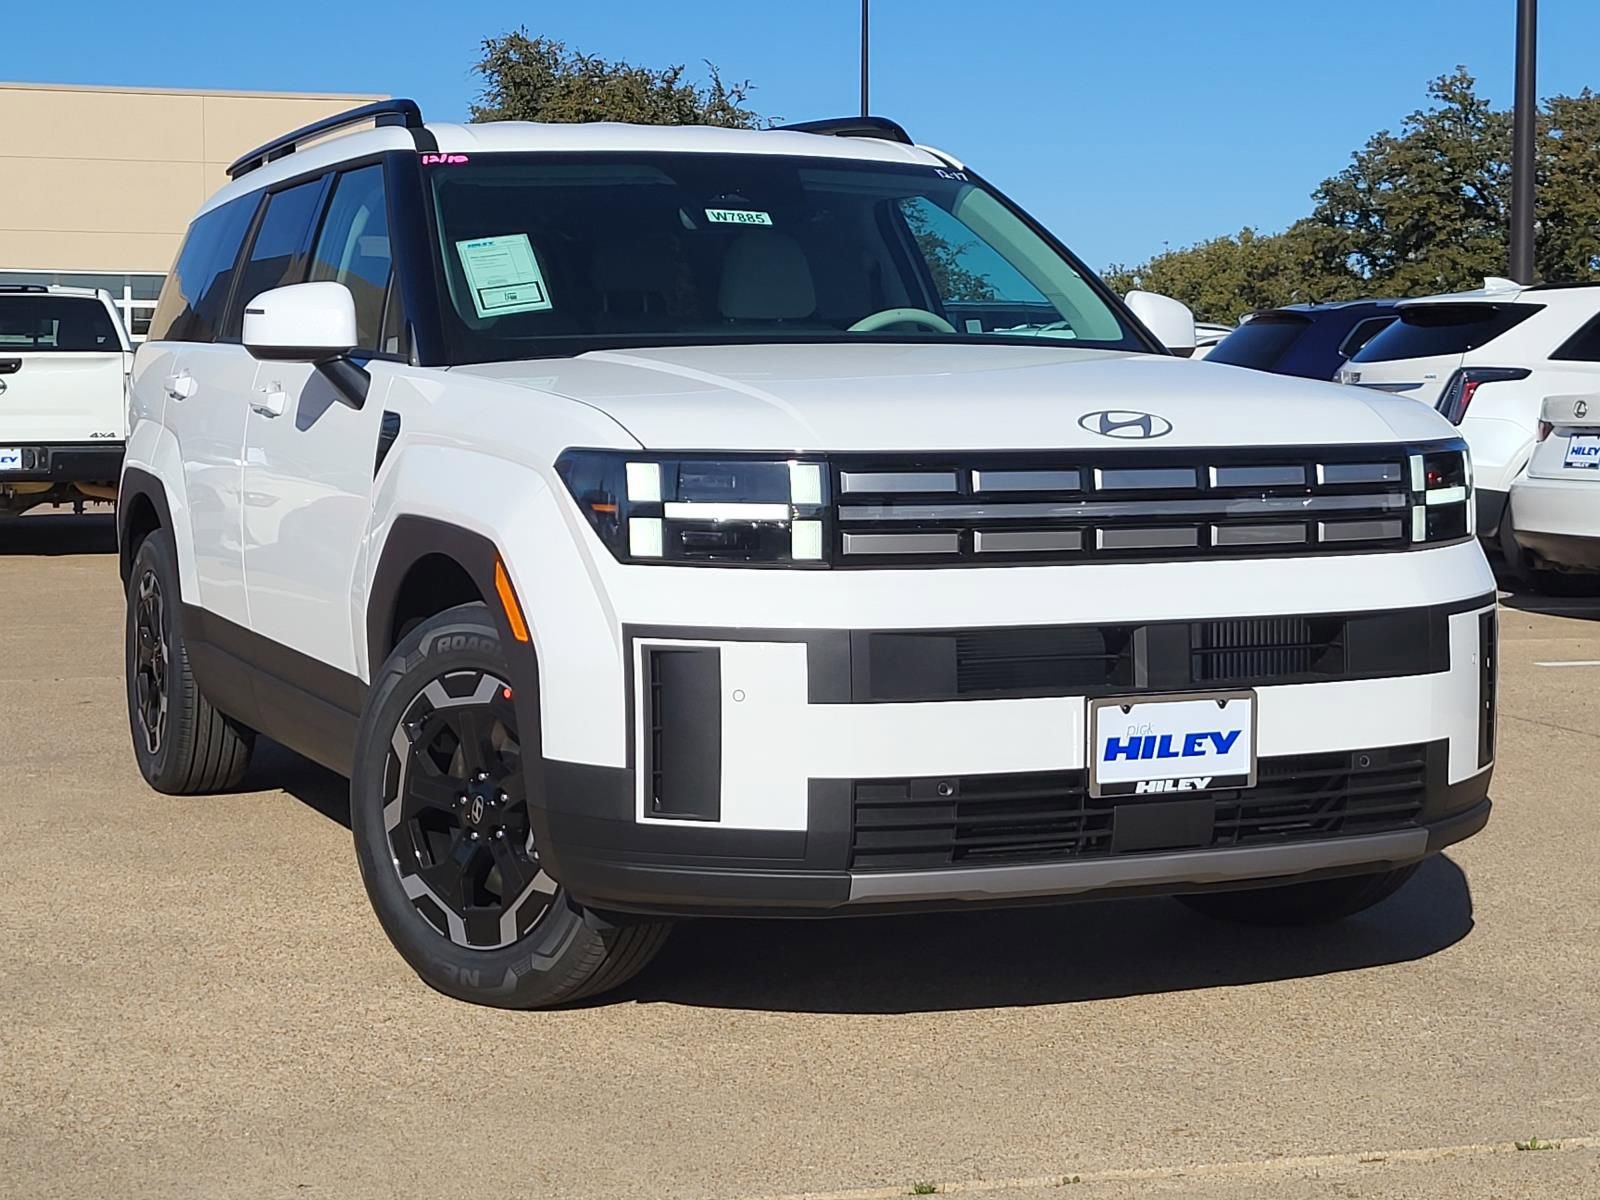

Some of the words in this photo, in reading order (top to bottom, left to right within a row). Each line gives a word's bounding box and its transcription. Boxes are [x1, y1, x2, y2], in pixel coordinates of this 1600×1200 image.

[710, 211, 765, 223] W7885
[1103, 730, 1242, 762] HILEY
[1135, 777, 1213, 794] HILEY
